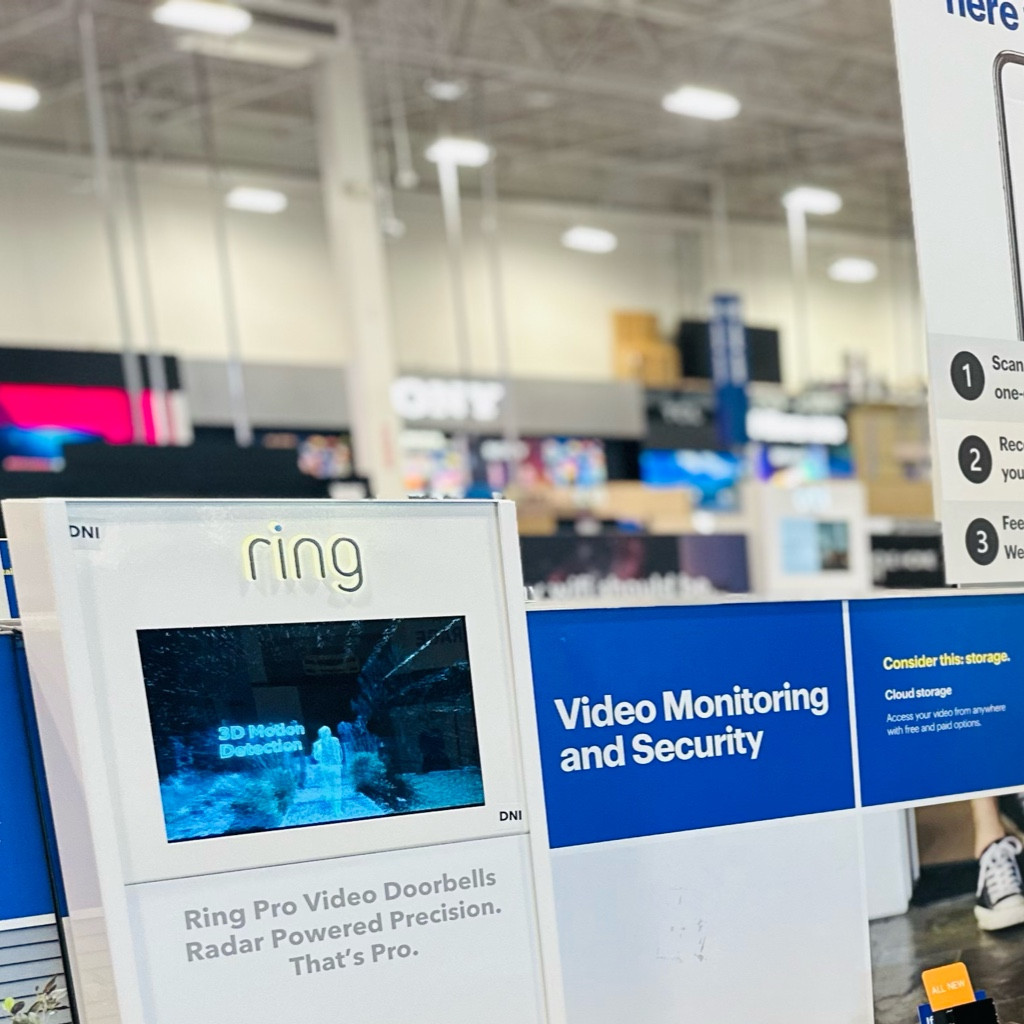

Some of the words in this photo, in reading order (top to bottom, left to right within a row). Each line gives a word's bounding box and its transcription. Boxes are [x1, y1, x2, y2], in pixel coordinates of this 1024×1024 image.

[992, 356, 1024, 372] Scan
[962, 363, 972, 387] 1
[970, 448, 982, 472] 2
[69, 525, 100, 539] DNI
[976, 530, 989, 553] 3
[247, 523, 364, 593] ring
[883, 654, 938, 670] Consider
[940, 652, 964, 667] this:
[966, 652, 1011, 666] storage.
[885, 688, 915, 700] Cloud
[916, 686, 952, 699] storage
[555, 694, 656, 730] Video
[663, 682, 829, 722] Monitoring
[886, 714, 914, 723] Access
[914, 712, 931, 722] your
[933, 708, 953, 718] video
[954, 706, 971, 717] from
[972, 704, 1006, 716] anywhere
[218, 726, 246, 741] 3D
[248, 723, 305, 739] Motion
[887, 726, 903, 736] with
[904, 724, 920, 735] free
[921, 722, 935, 732] and
[936, 720, 953, 732] paid
[954, 719, 982, 731] options.
[220, 738, 303, 759] Detection
[560, 735, 626, 772] and
[632, 726, 764, 765] Security
[500, 810, 522, 822] DNI
[184, 906, 246, 930] Ring
[254, 900, 298, 920] Pro
[303, 888, 378, 913] Video
[384, 868, 497, 901] Doorbells
[186, 934, 264, 962] Radar
[271, 913, 383, 948] Powered
[390, 902, 502, 930] Precision.
[289, 949, 365, 976] That's
[372, 943, 419, 963] Pro.
[932, 986, 946, 994] ALL
[947, 980, 966, 990] NEW
